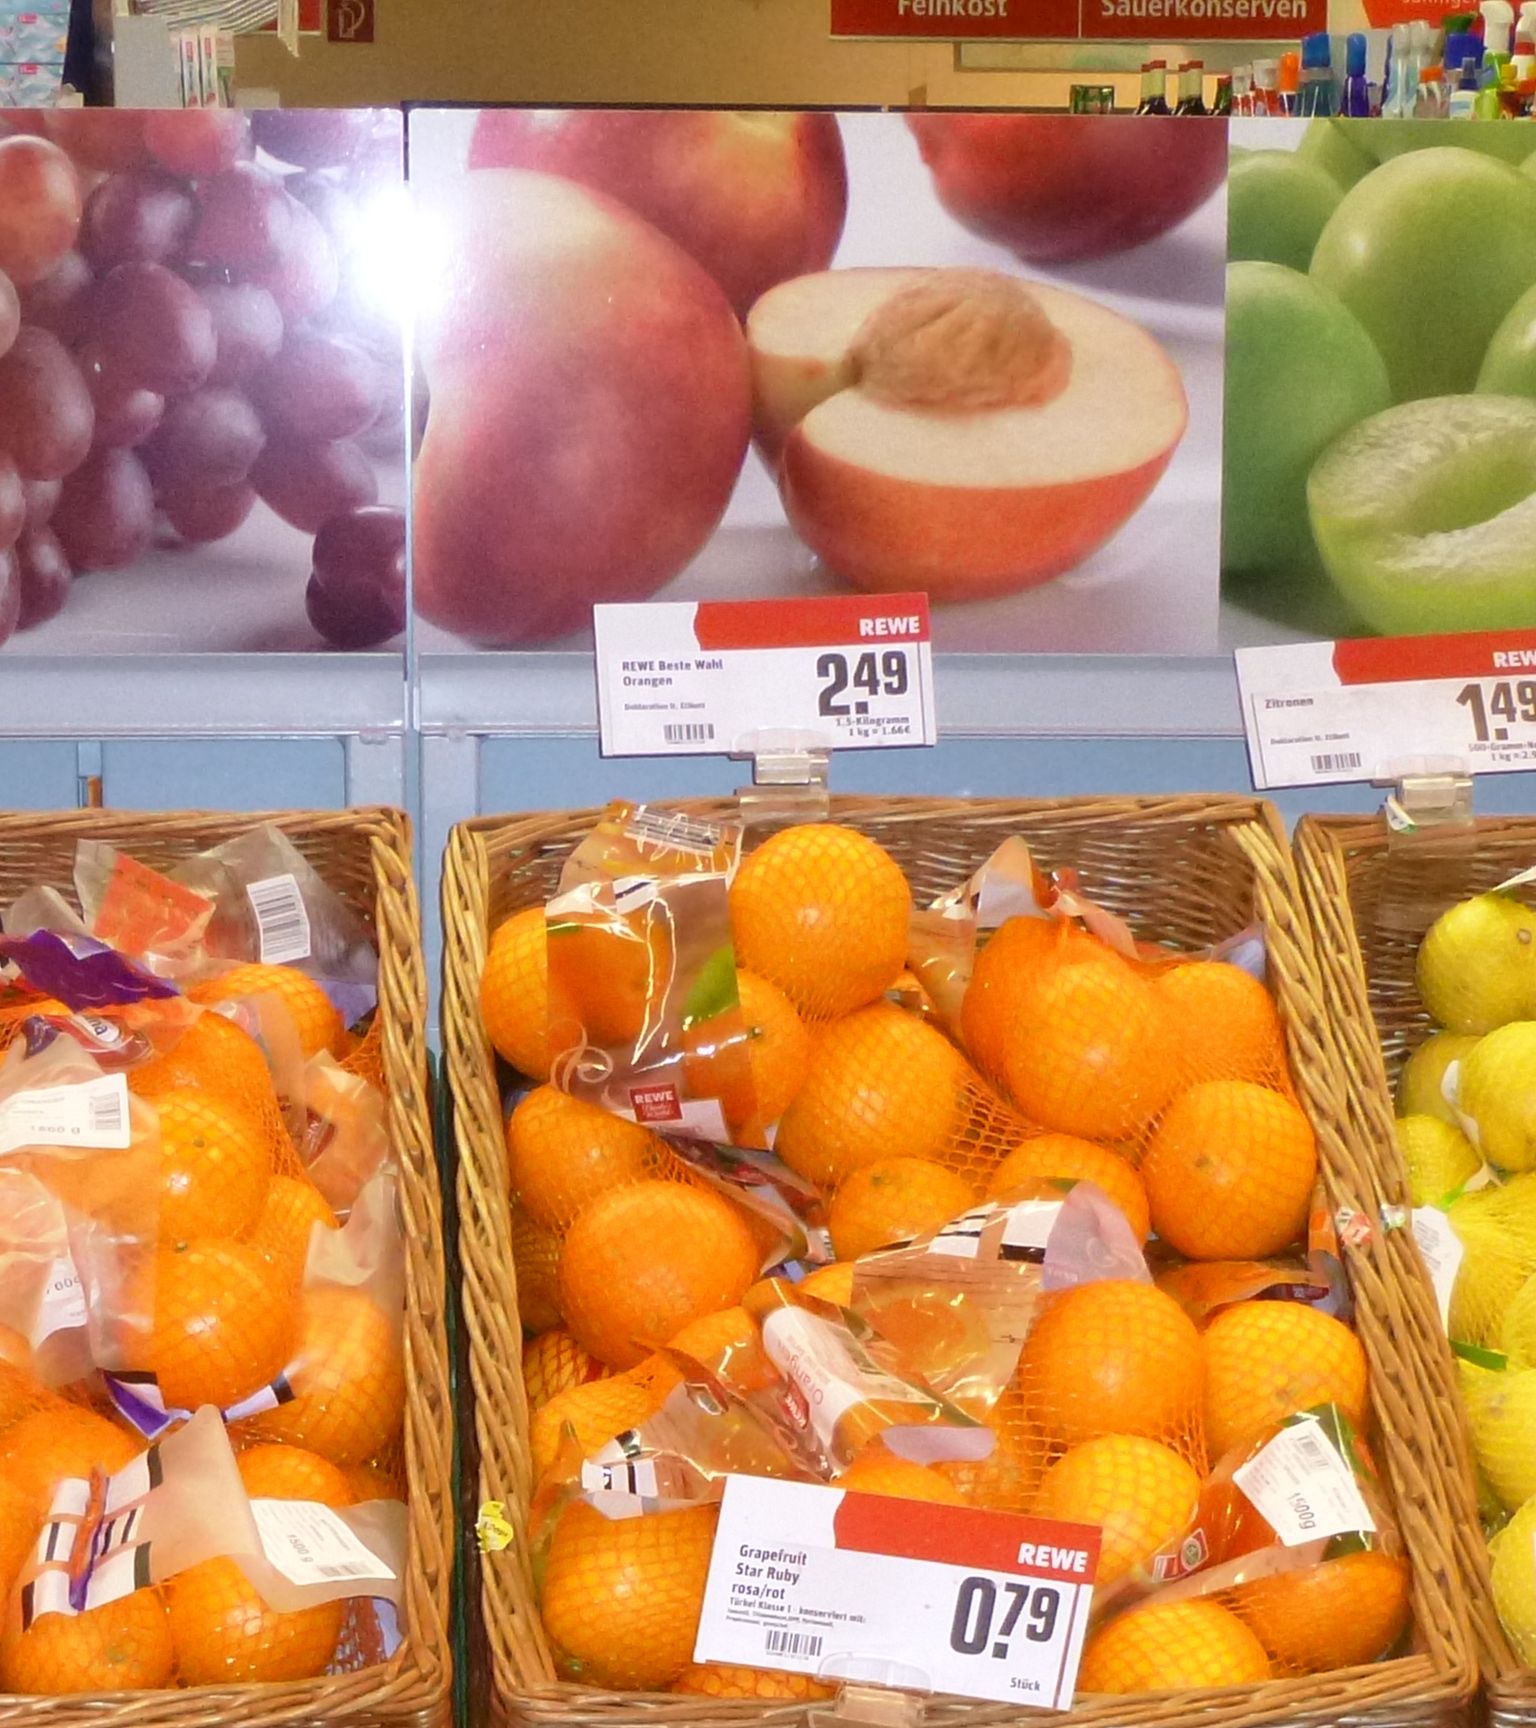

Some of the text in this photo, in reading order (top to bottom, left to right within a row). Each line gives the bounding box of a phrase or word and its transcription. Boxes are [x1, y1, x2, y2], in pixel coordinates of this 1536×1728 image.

[898, 0, 1007, 18] Feinkost
[1101, 0, 1308, 18] Sauerkonserven
[859, 616, 921, 636] REWE
[622, 658, 724, 672] REWE Beste Wahl
[622, 675, 673, 688] Orangen
[816, 650, 909, 717] 2.49
[1264, 696, 1314, 709] Zitronen
[634, 1090, 675, 1105] REWE
[739, 1543, 808, 1567] Grapefruit
[1017, 1542, 1089, 1574] REWE
[735, 1561, 801, 1586] Star Ruby
[731, 1580, 786, 1601] rosa/rot
[949, 1575, 1062, 1661] 0.79
[1009, 1676, 1042, 1692] Stück
